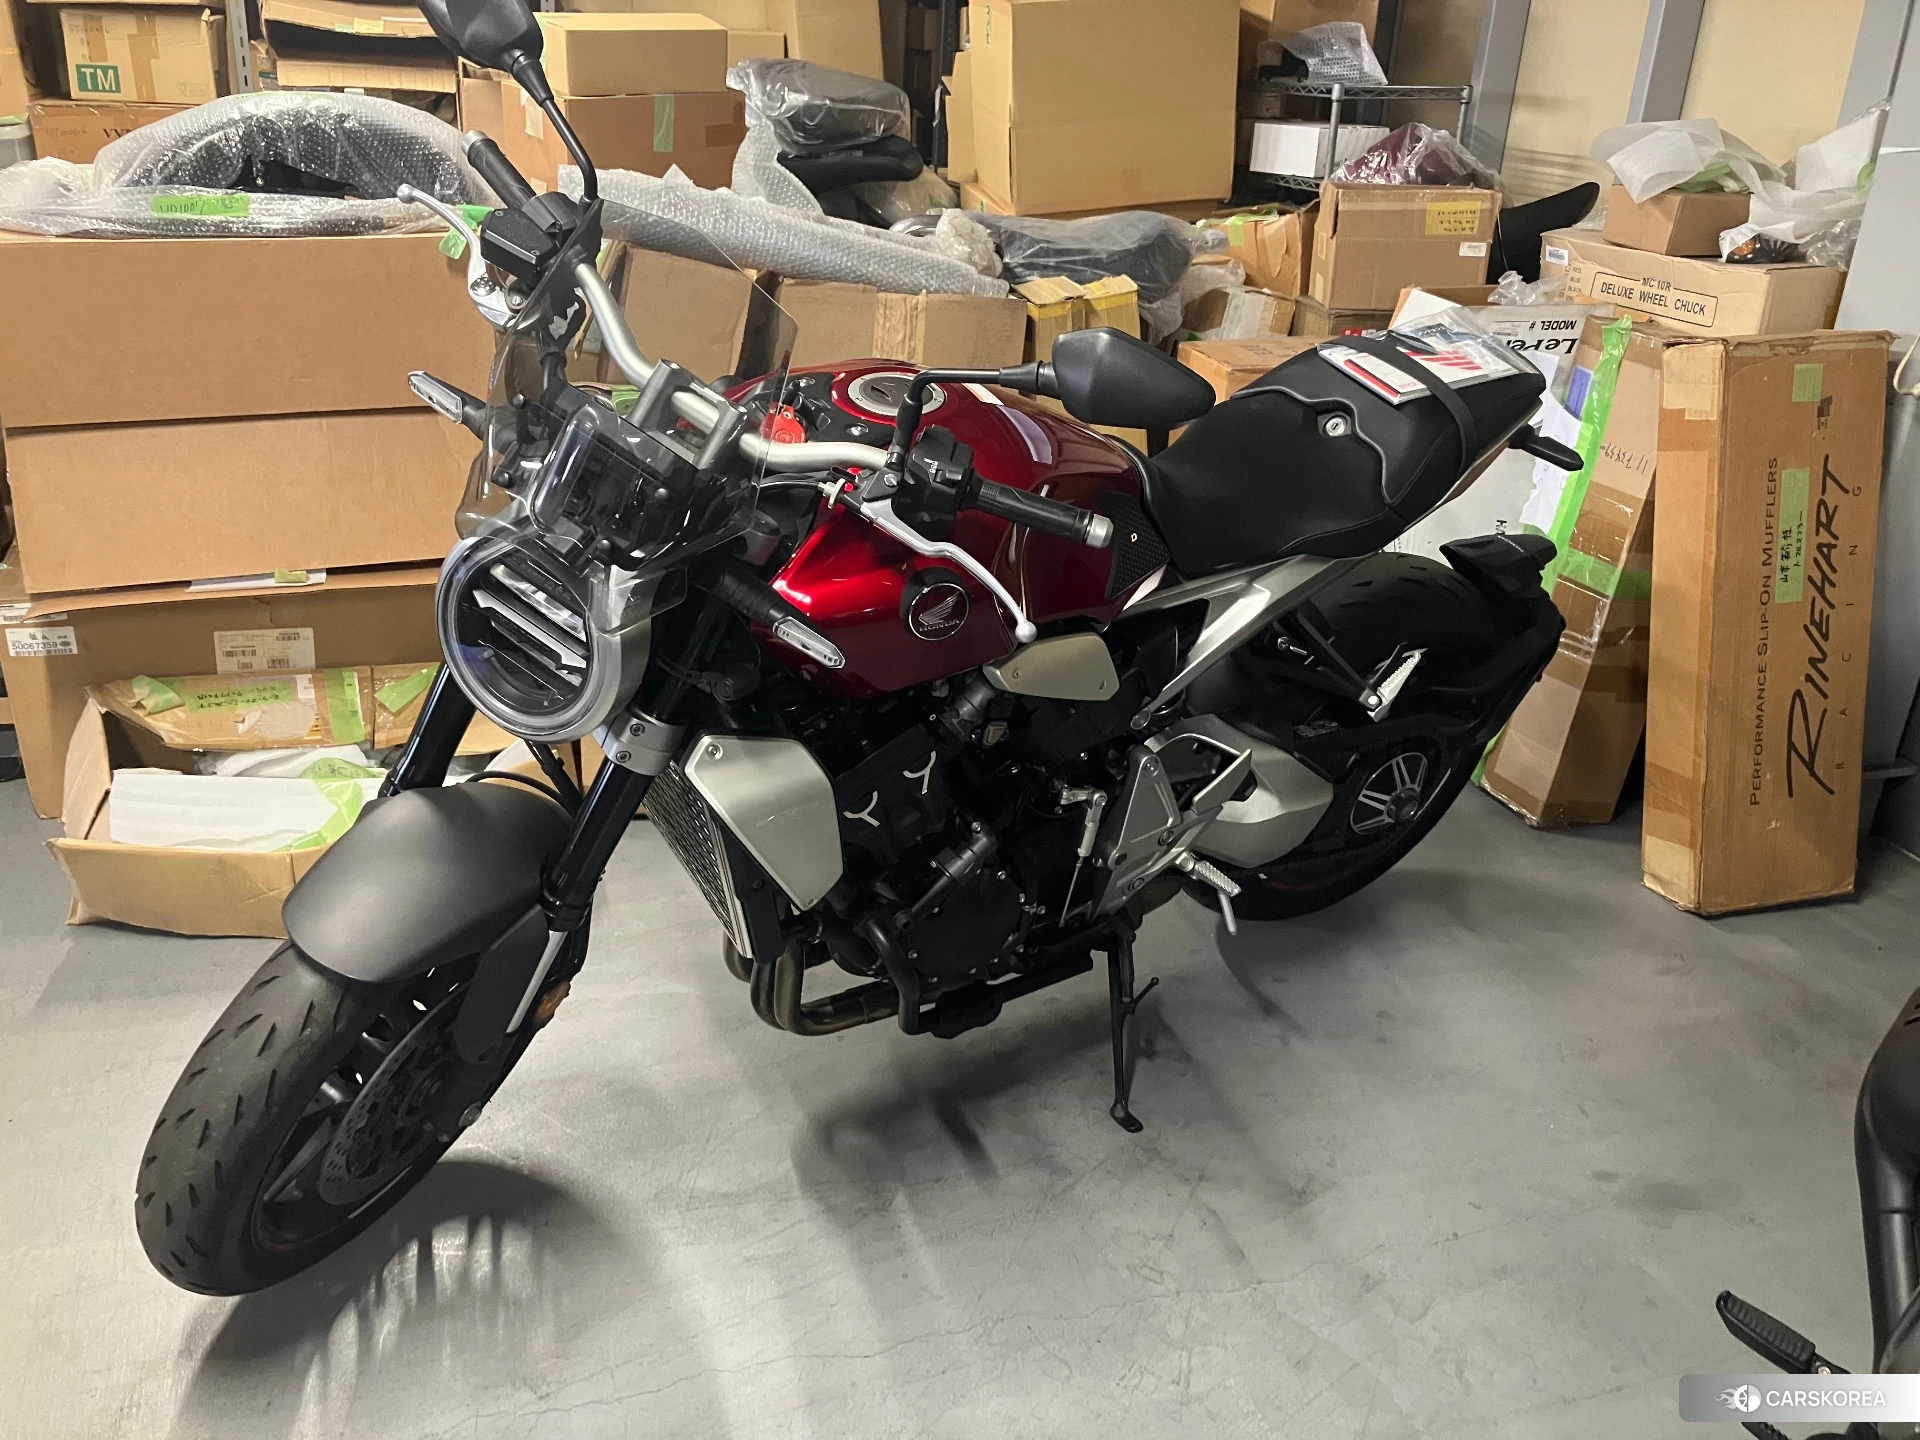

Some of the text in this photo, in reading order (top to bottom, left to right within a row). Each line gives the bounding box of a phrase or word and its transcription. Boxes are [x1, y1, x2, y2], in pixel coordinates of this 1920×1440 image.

[80, 67, 117, 92] TM
[1641, 277, 1656, 288] MC
[1600, 281, 1707, 317] DELUXE WHEEL CHUCK
[1540, 320, 1578, 331] MODEL
[1750, 456, 1778, 806] PERFORMANCE SLIP-ON MUFFLERS
[1785, 453, 1851, 799] RINEHART
[1835, 486, 1862, 770] RACING
[11, 641, 58, 650] 50067359
